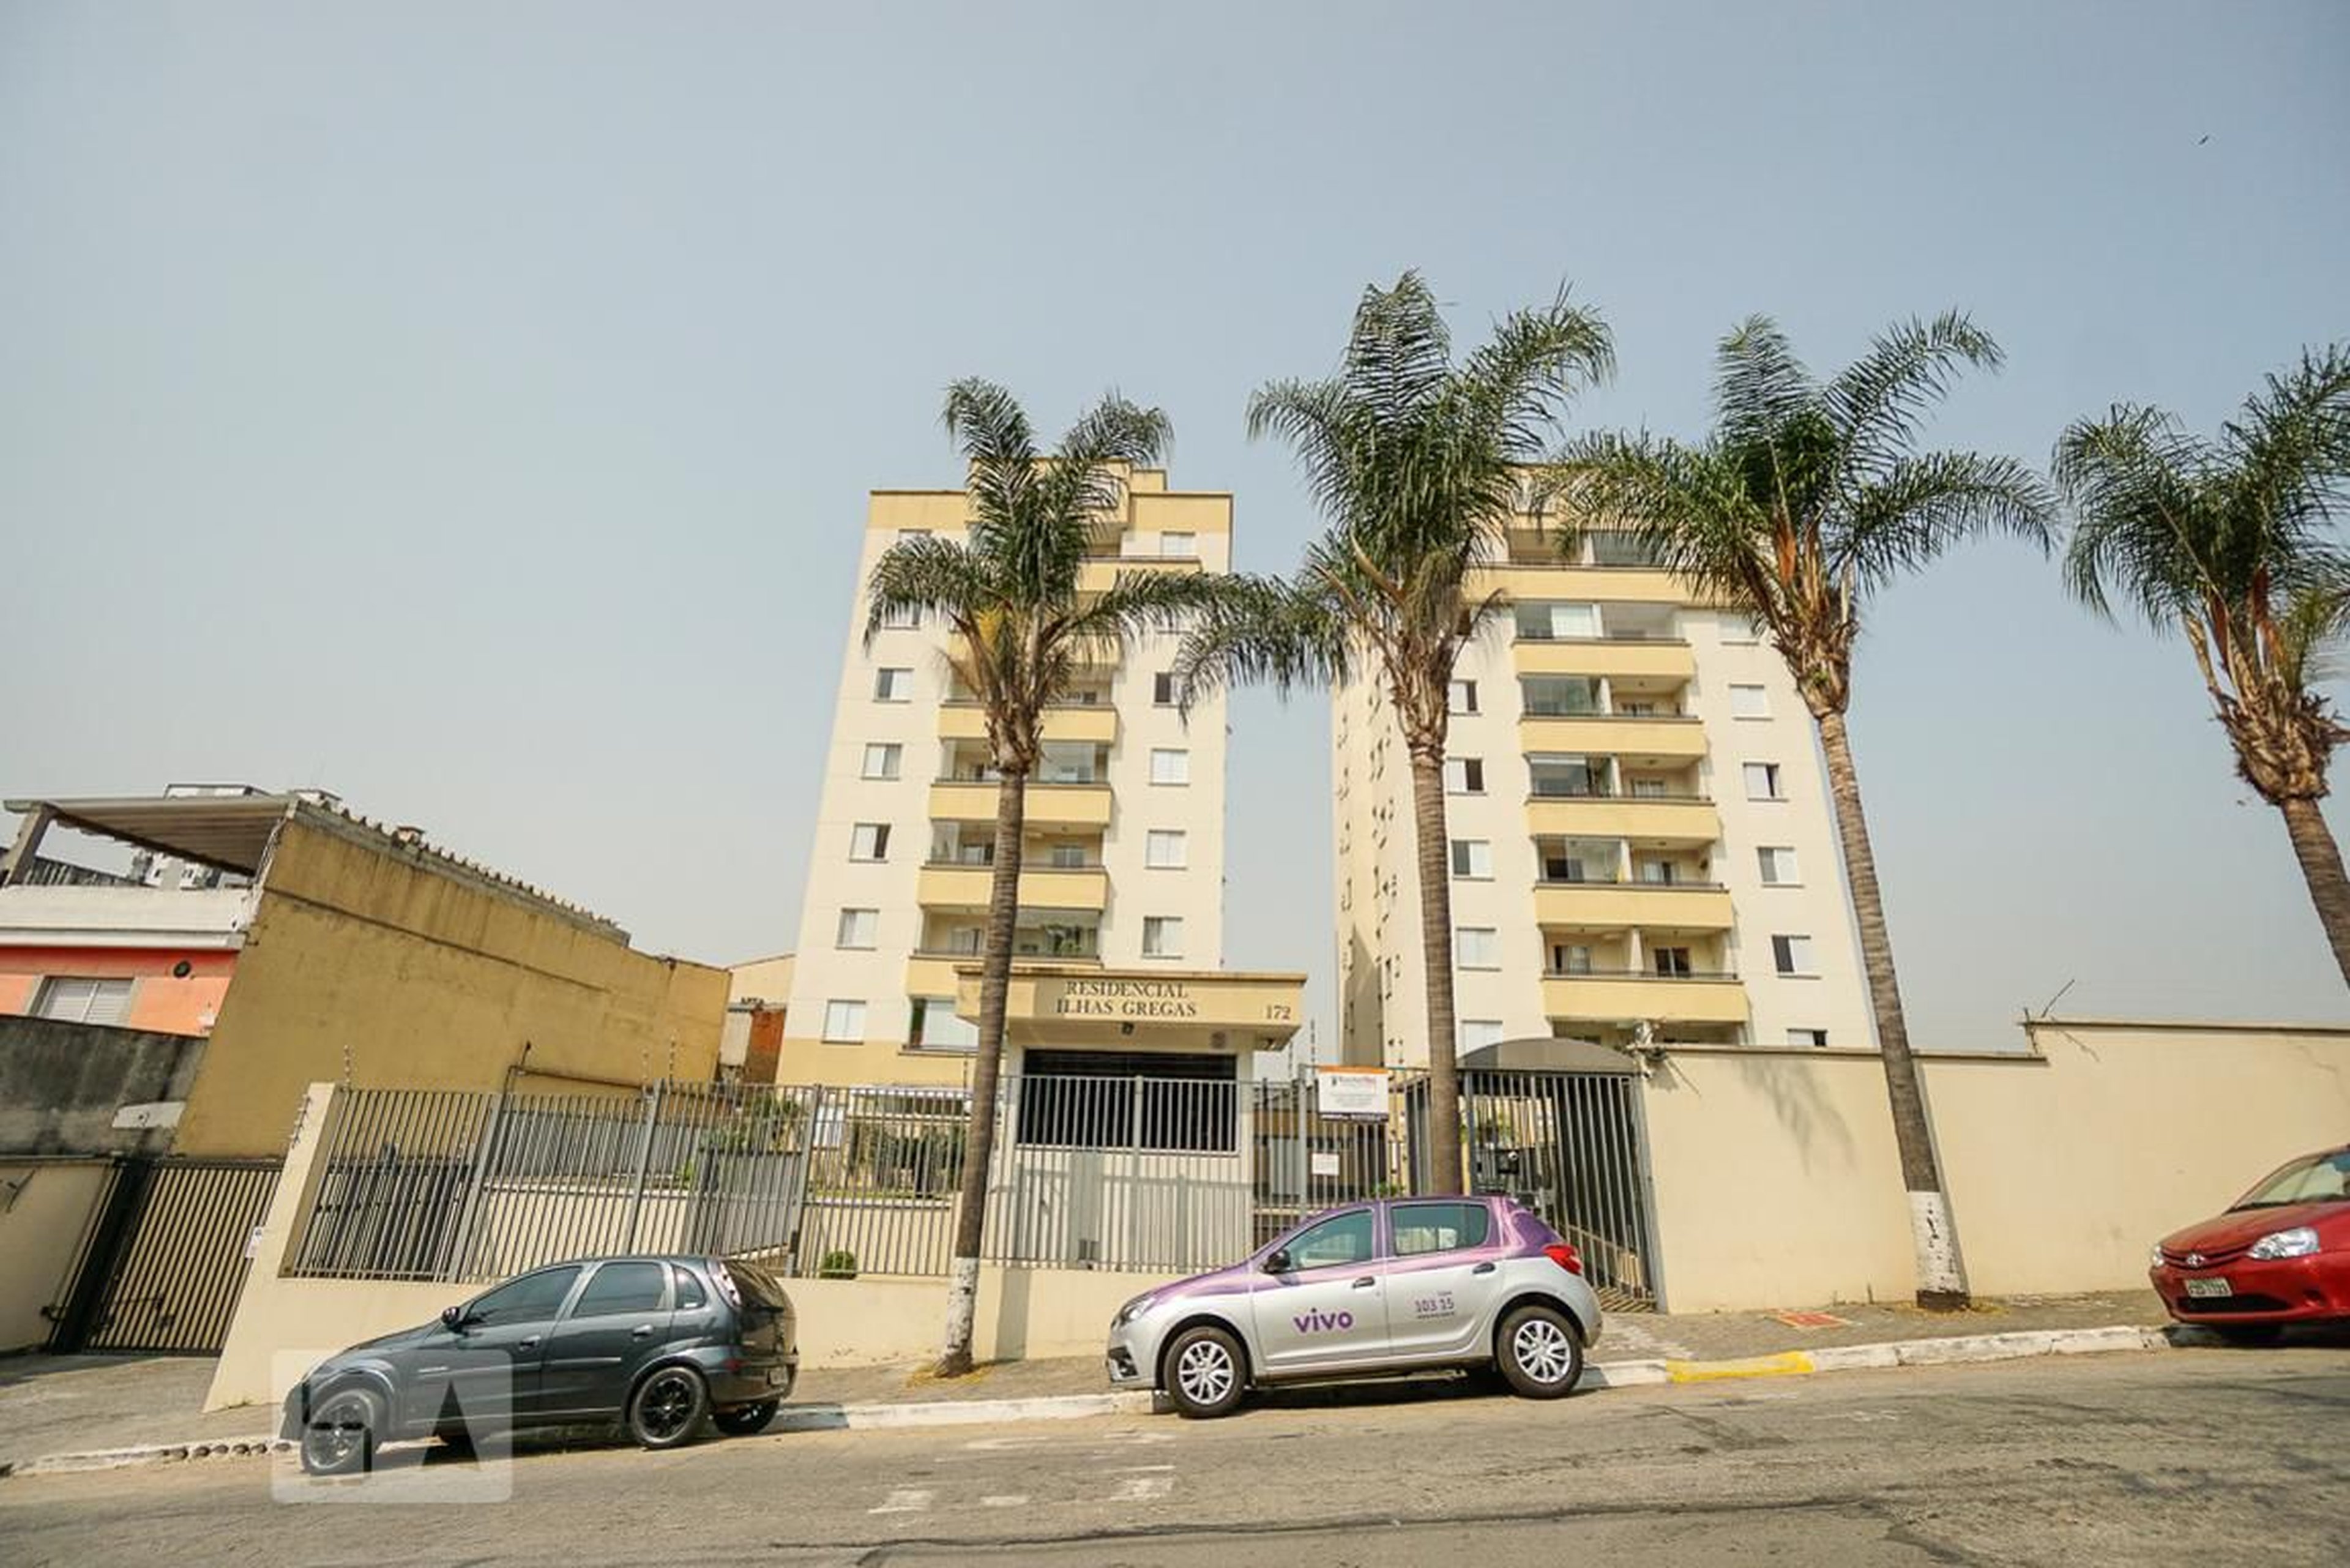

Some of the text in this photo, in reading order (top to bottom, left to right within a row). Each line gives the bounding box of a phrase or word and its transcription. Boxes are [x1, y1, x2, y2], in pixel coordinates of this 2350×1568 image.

[1065, 980, 1188, 998] RESIDENCIAL
[1056, 998, 1196, 1017] ILHAS GREGAS
[1266, 1004, 1291, 1020] 172
[1293, 1307, 1354, 1333] vivo
